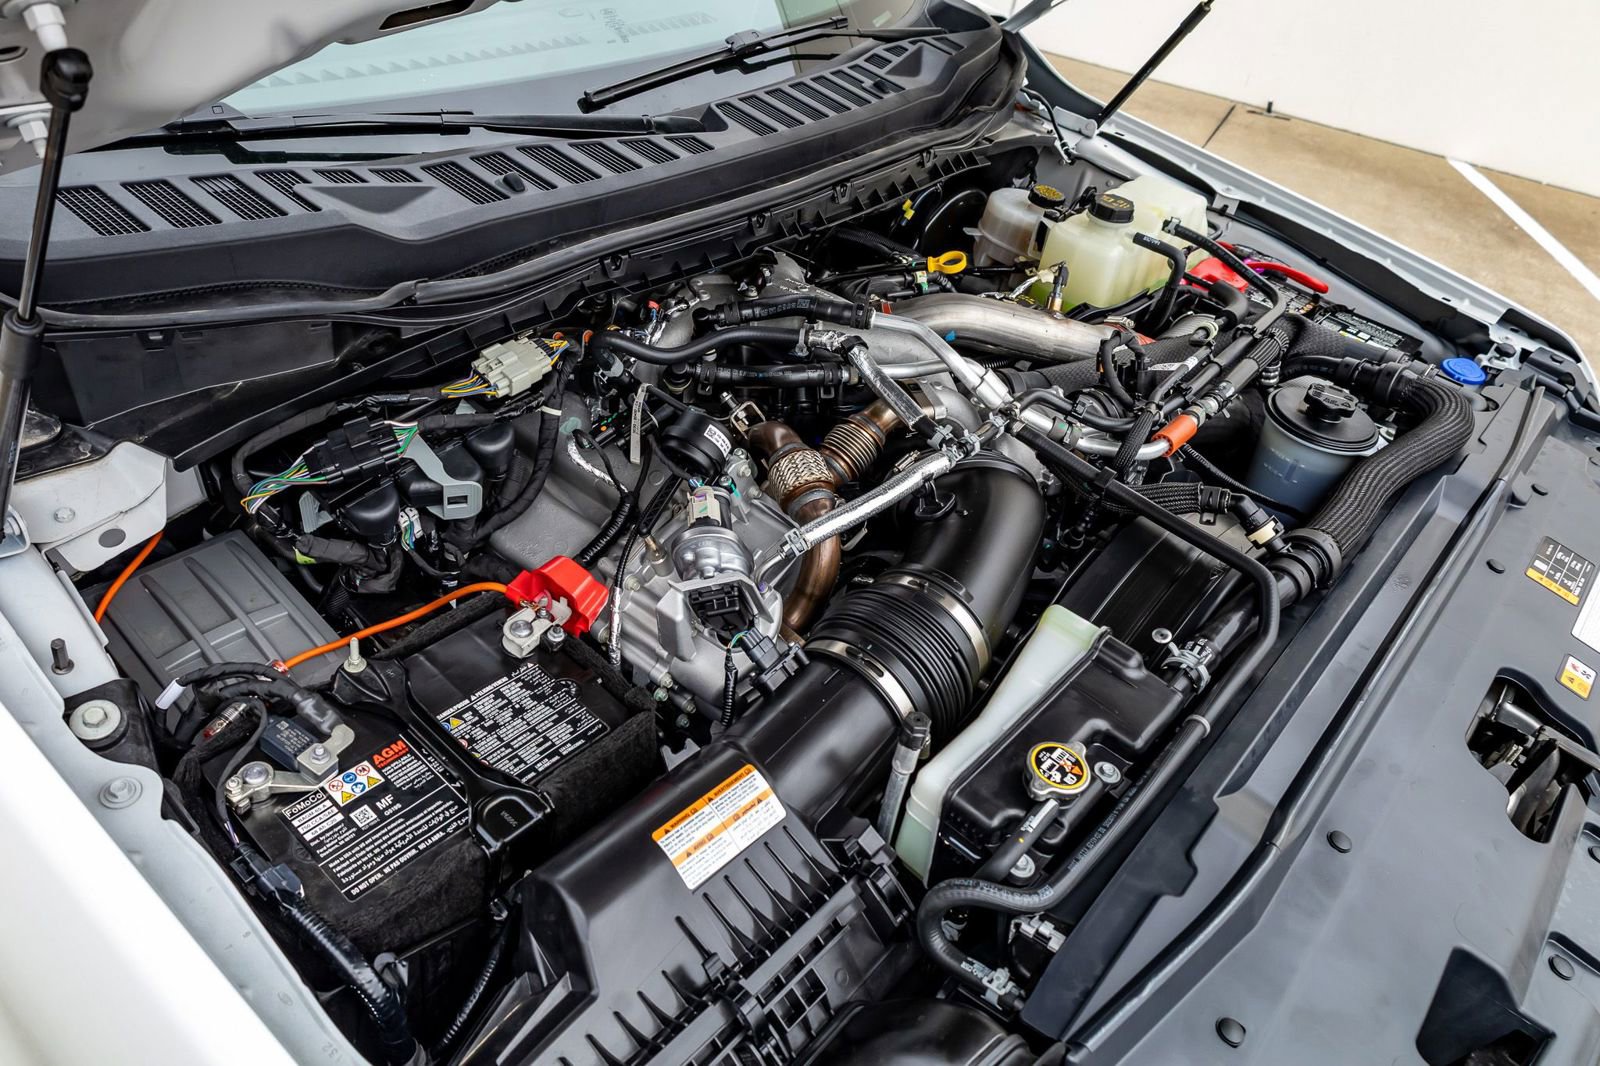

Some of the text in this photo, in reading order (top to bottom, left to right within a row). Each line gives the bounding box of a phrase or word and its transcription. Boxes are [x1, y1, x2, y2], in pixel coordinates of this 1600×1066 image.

[372, 740, 407, 766] AGM
[284, 791, 323, 817] FoMoCo
[375, 793, 396, 810] MF
[316, 846, 327, 854] Ford
[325, 839, 338, 848] Motor
[327, 858, 340, 868] Made
[342, 850, 352, 858] USA
[350, 845, 360, 853] with
[370, 827, 388, 840] imported
[350, 887, 360, 895] DO
[357, 880, 369, 890] NOT
[367, 871, 384, 883] OPEN.
[389, 860, 400, 869] PAS
[398, 847, 418, 862] OUVRIR.
[417, 842, 426, 850] NO
[430, 830, 445, 841] ABRA.
